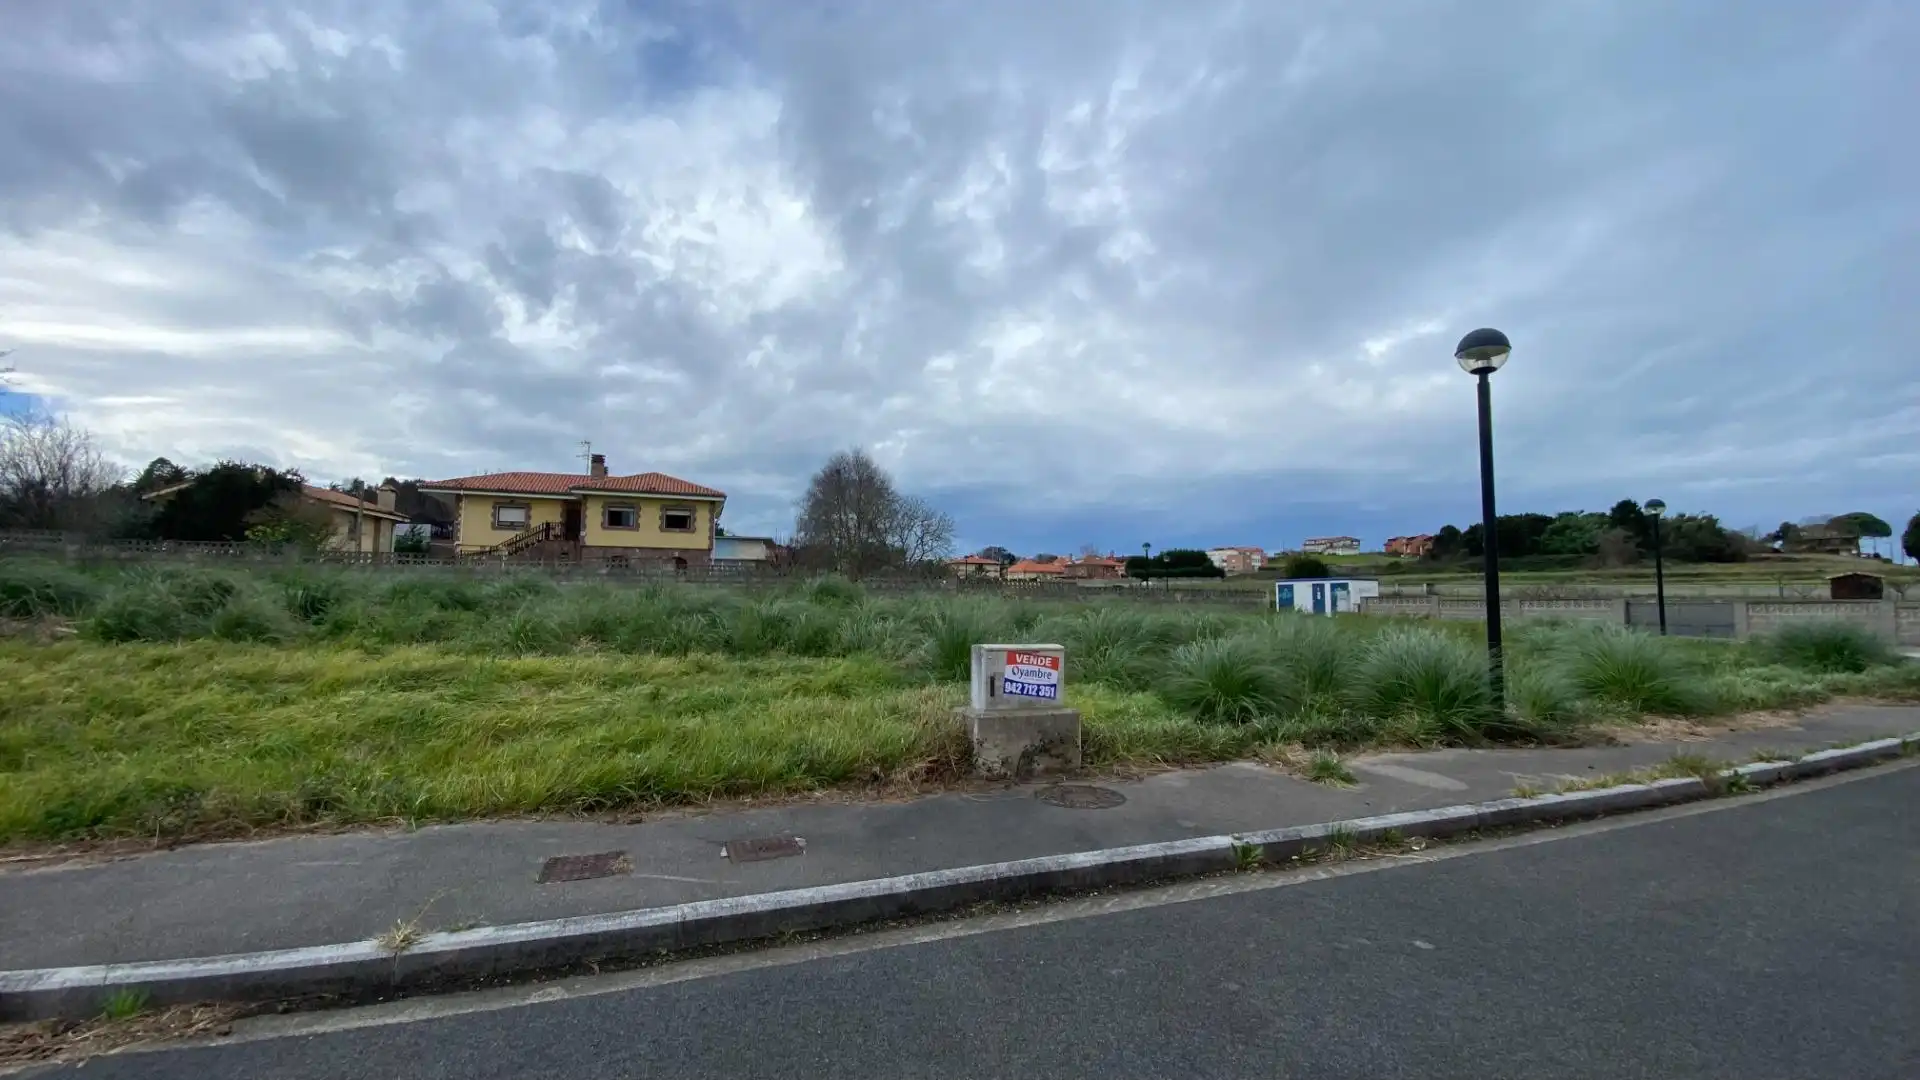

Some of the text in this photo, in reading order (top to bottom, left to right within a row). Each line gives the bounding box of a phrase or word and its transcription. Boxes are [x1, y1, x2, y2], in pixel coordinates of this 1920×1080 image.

[1015, 653, 1052, 667] VENDE
[1011, 665, 1052, 680] Oyambre
[1004, 681, 1055, 698] 942 712 351
